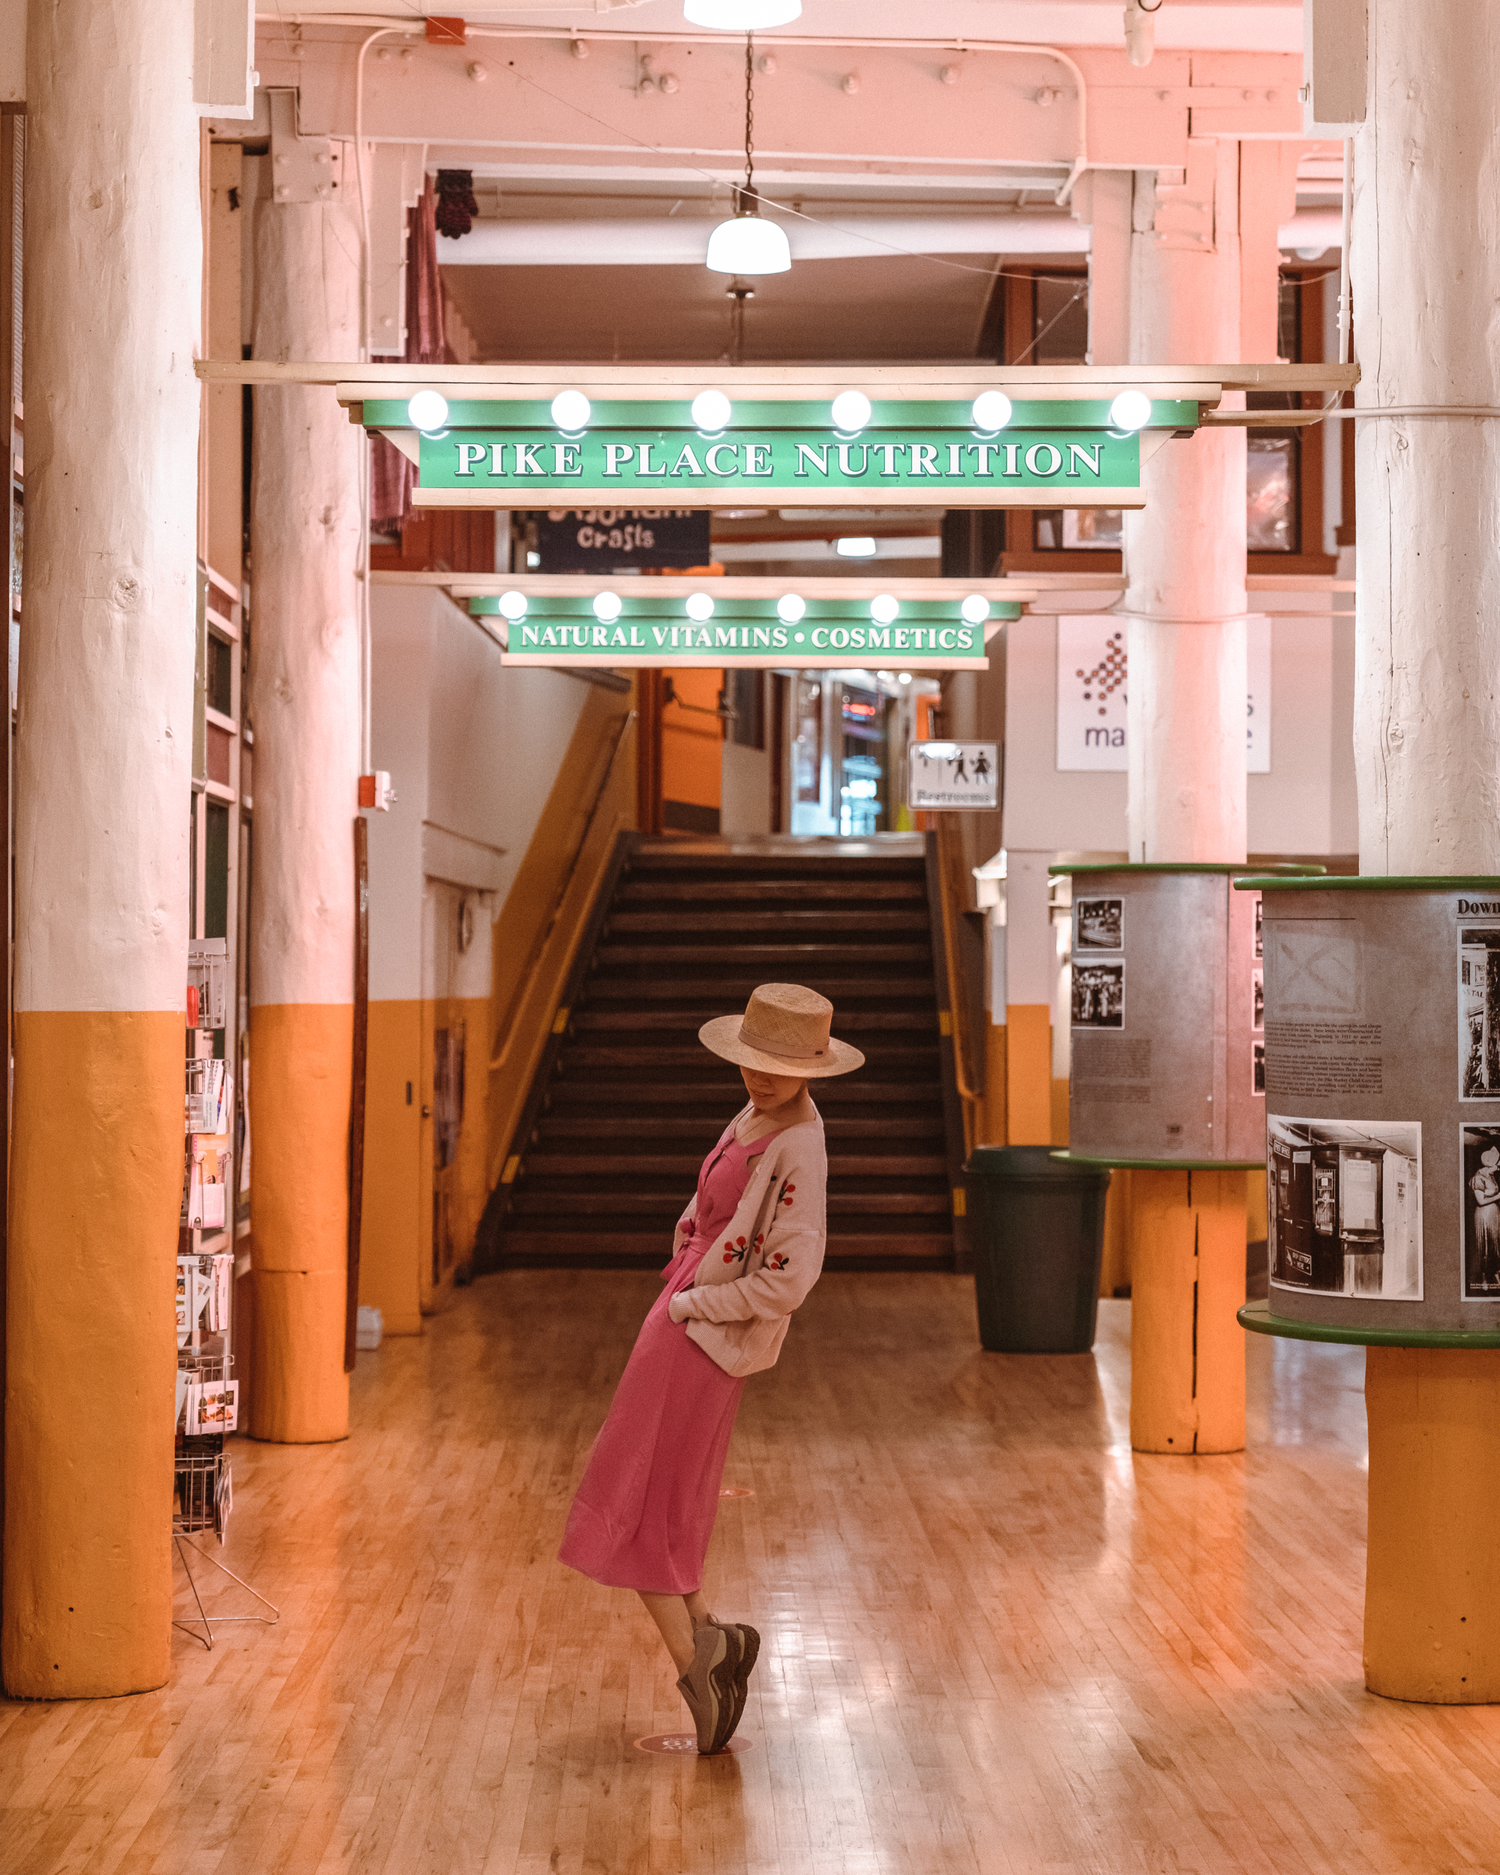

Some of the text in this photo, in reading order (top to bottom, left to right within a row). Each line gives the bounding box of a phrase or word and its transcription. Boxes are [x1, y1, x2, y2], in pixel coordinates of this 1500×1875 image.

[455, 442, 1103, 478] PIKE PLACE NUTRITION
[577, 523, 655, 552] Crafts
[521, 625, 974, 650] NATURAL VITAMINS COSMETICS
[917, 789, 992, 803] Restrooms
